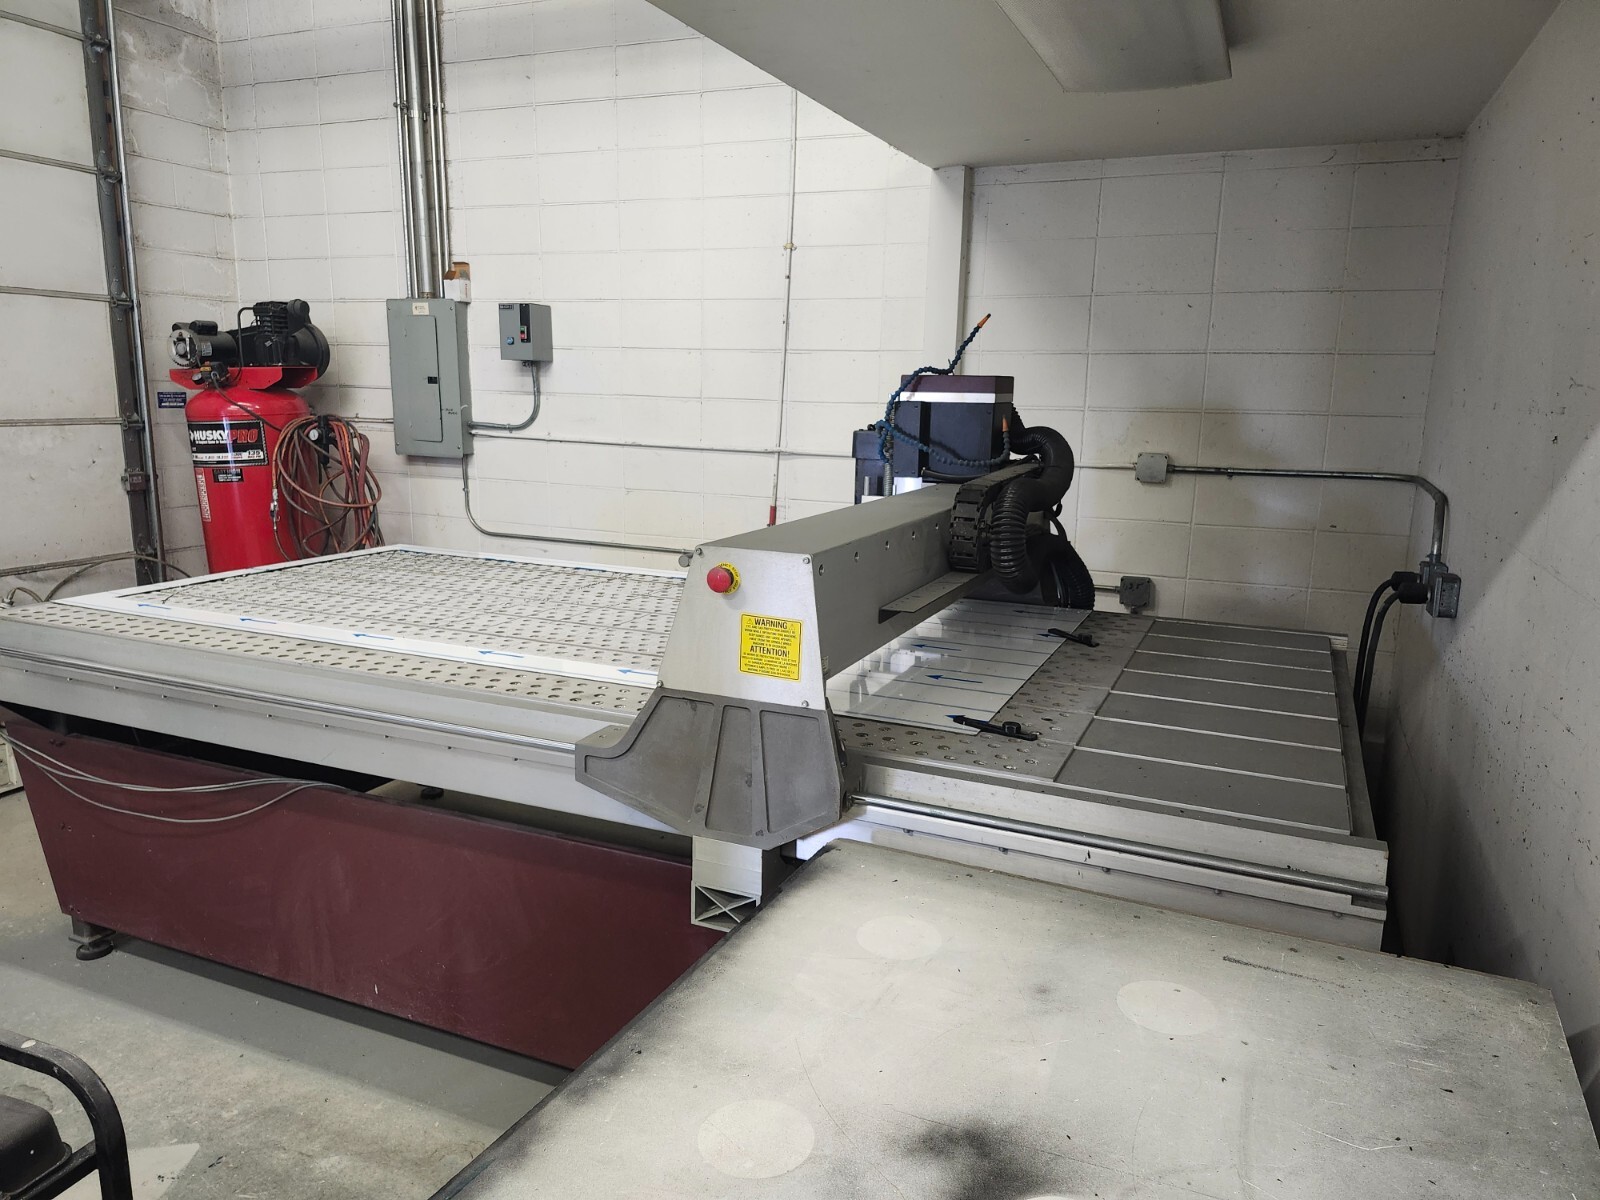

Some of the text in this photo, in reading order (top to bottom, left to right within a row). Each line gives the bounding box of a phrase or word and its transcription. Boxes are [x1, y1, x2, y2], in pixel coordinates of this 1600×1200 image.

[194, 429, 258, 443] HUSKY PRO
[754, 618, 787, 630] WARNING
[750, 645, 790, 658] ATTENTION!
